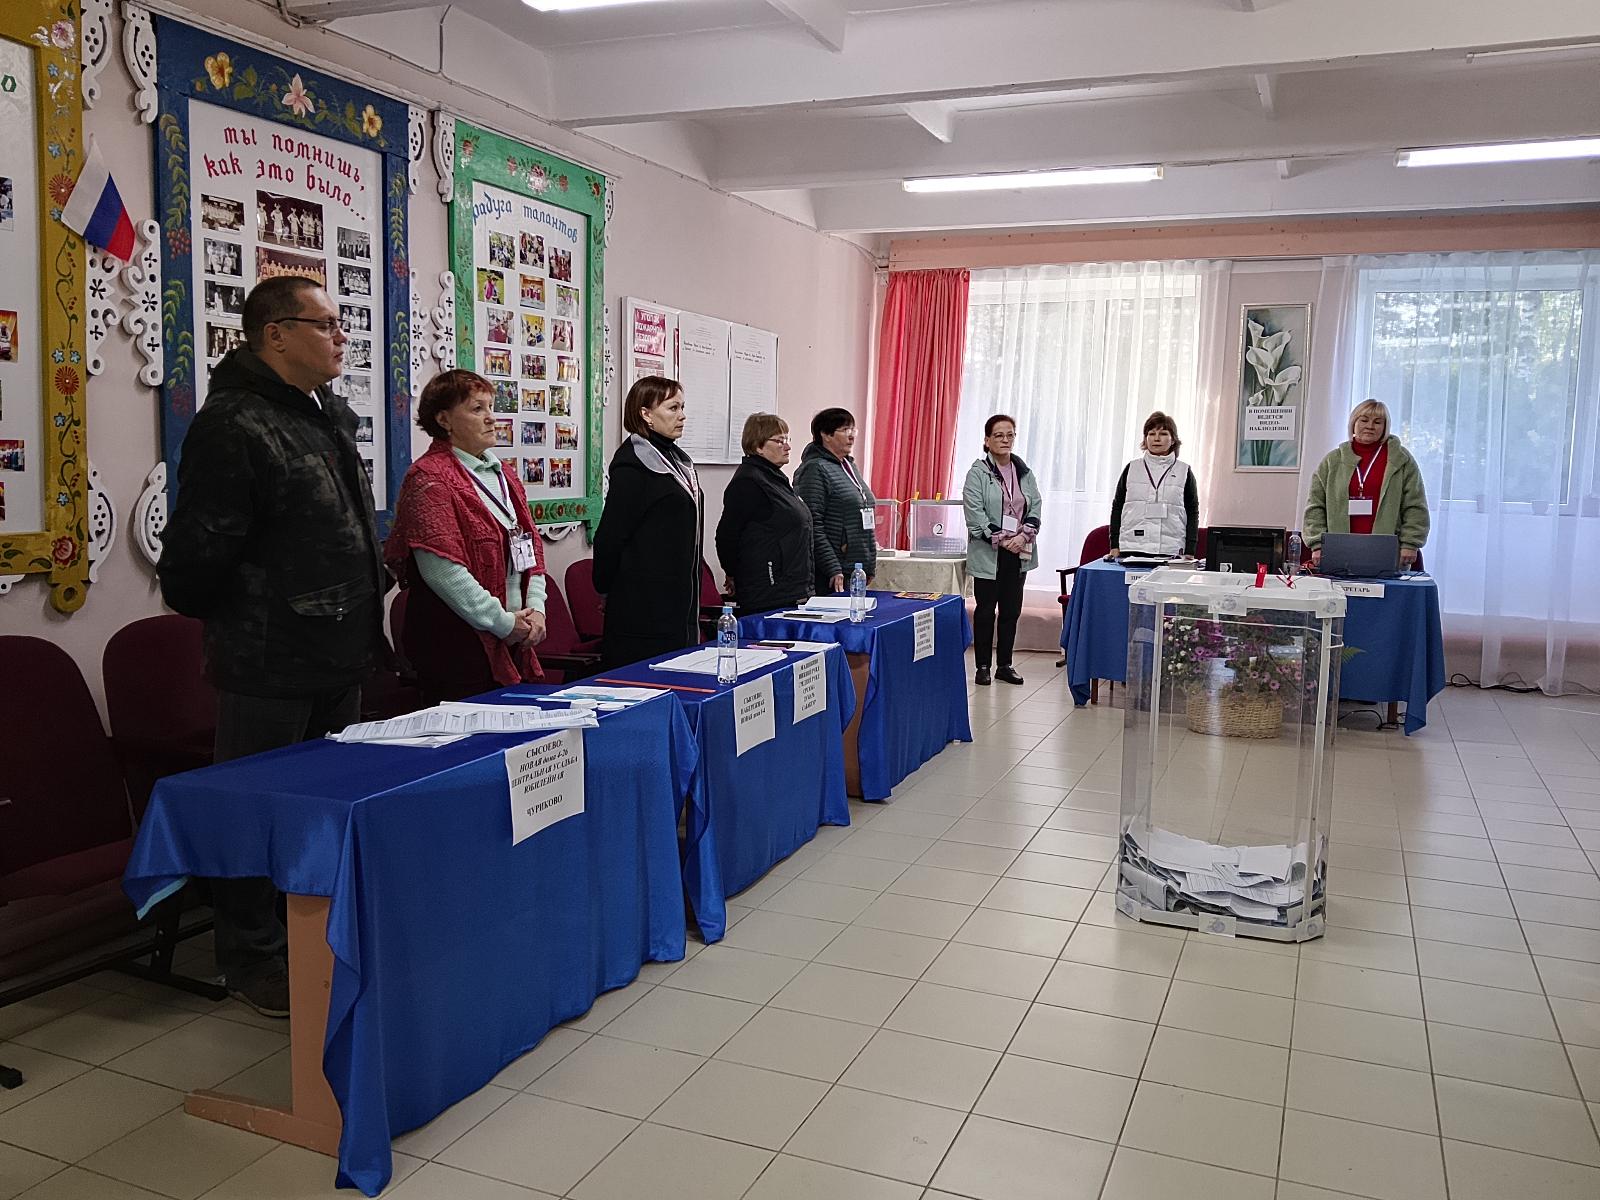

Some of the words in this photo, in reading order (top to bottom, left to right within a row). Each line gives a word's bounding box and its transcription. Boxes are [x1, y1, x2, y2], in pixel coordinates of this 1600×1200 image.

[203, 151, 243, 178] как
[256, 159, 294, 183] это
[523, 205, 578, 243] талантов
[526, 794, 563, 817] ЧУРИКОВО
